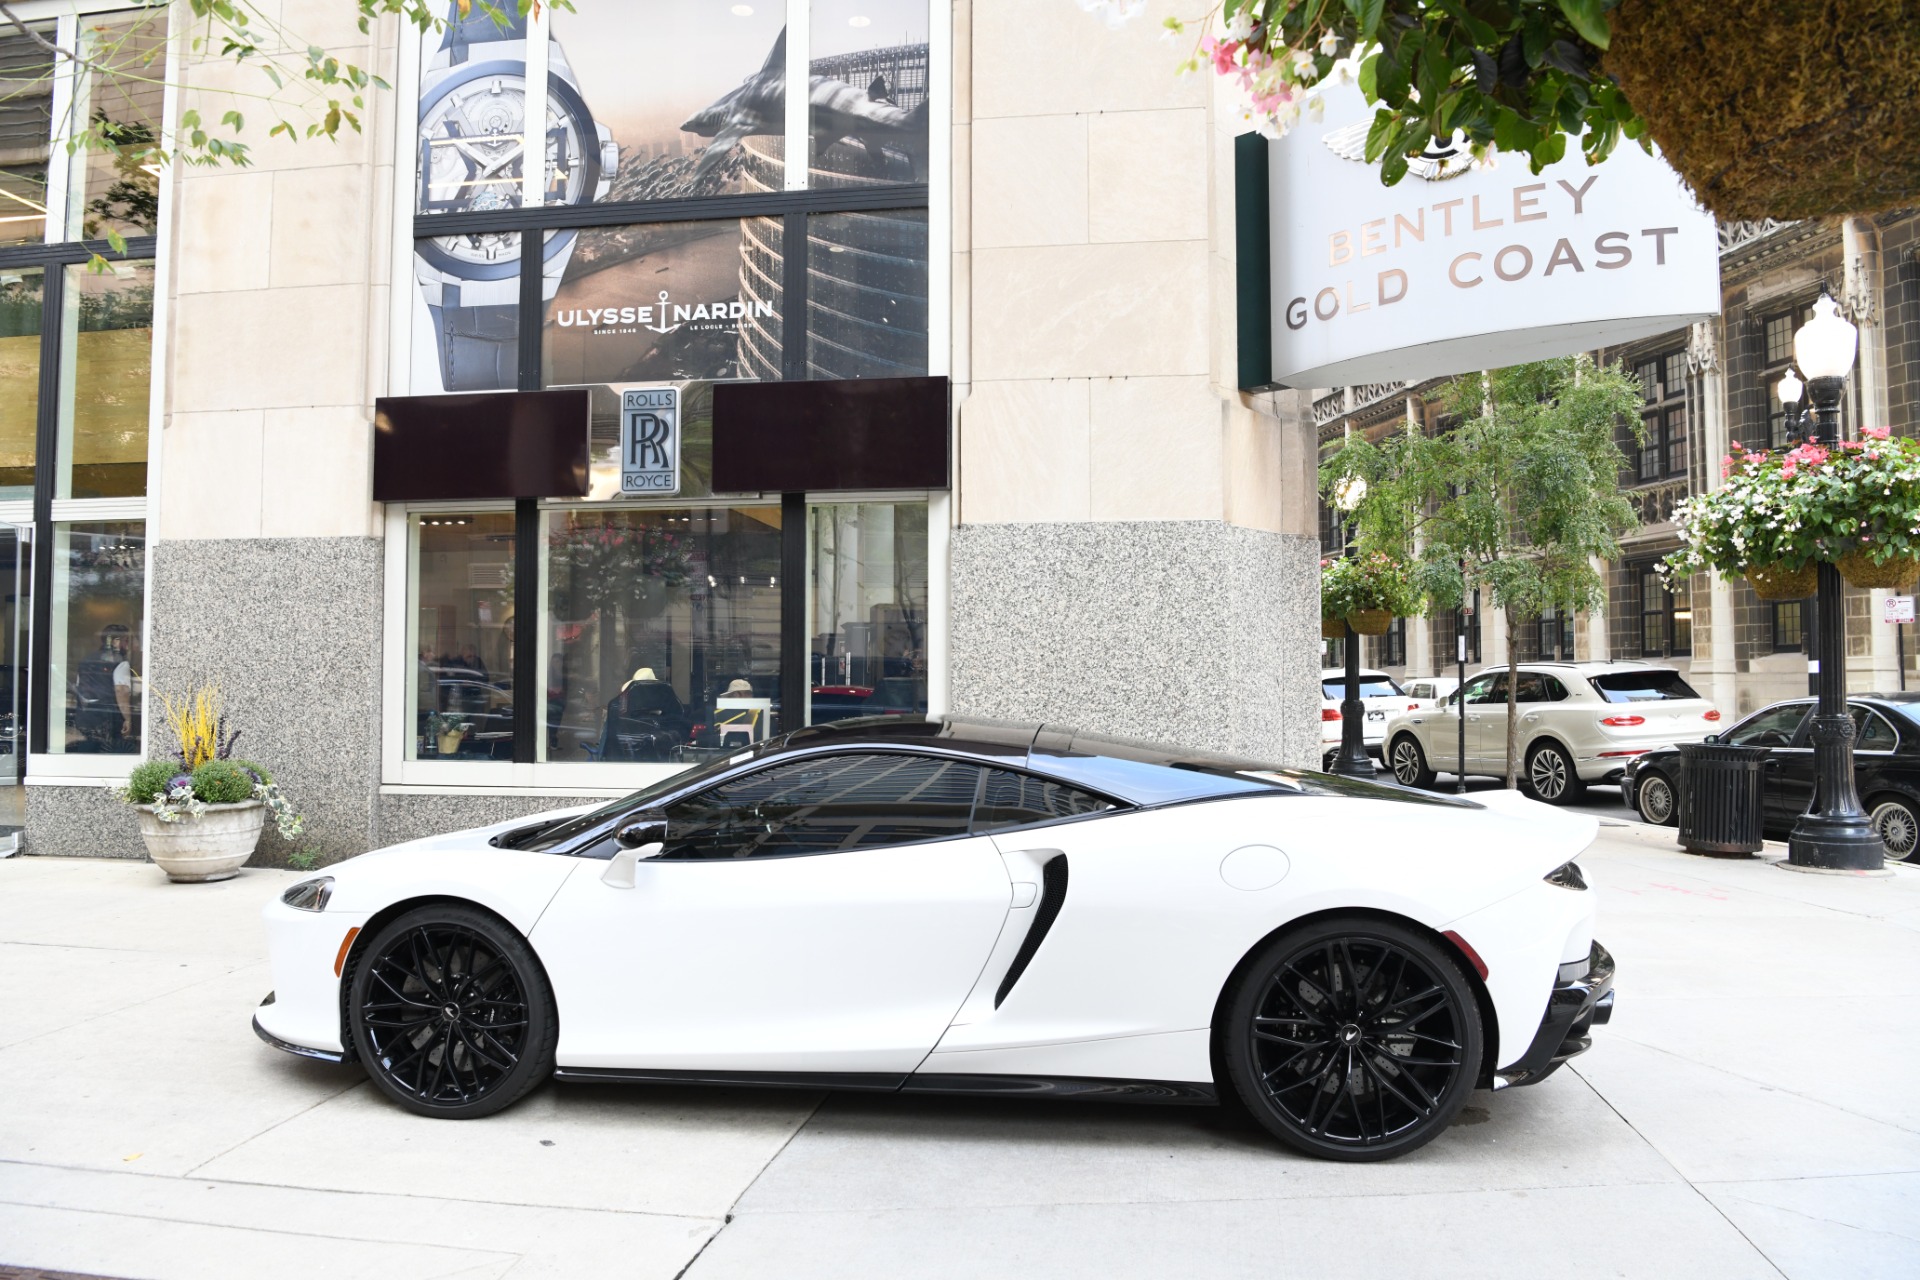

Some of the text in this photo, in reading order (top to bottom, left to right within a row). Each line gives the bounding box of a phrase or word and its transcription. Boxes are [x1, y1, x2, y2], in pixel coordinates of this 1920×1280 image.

[1329, 175, 1599, 268] BENTLEY
[1286, 226, 1679, 330] GOLD COAST
[557, 300, 773, 327] ULYSSE NARDIN
[627, 393, 673, 407] ROLLS
[626, 475, 672, 488] ROYCE
